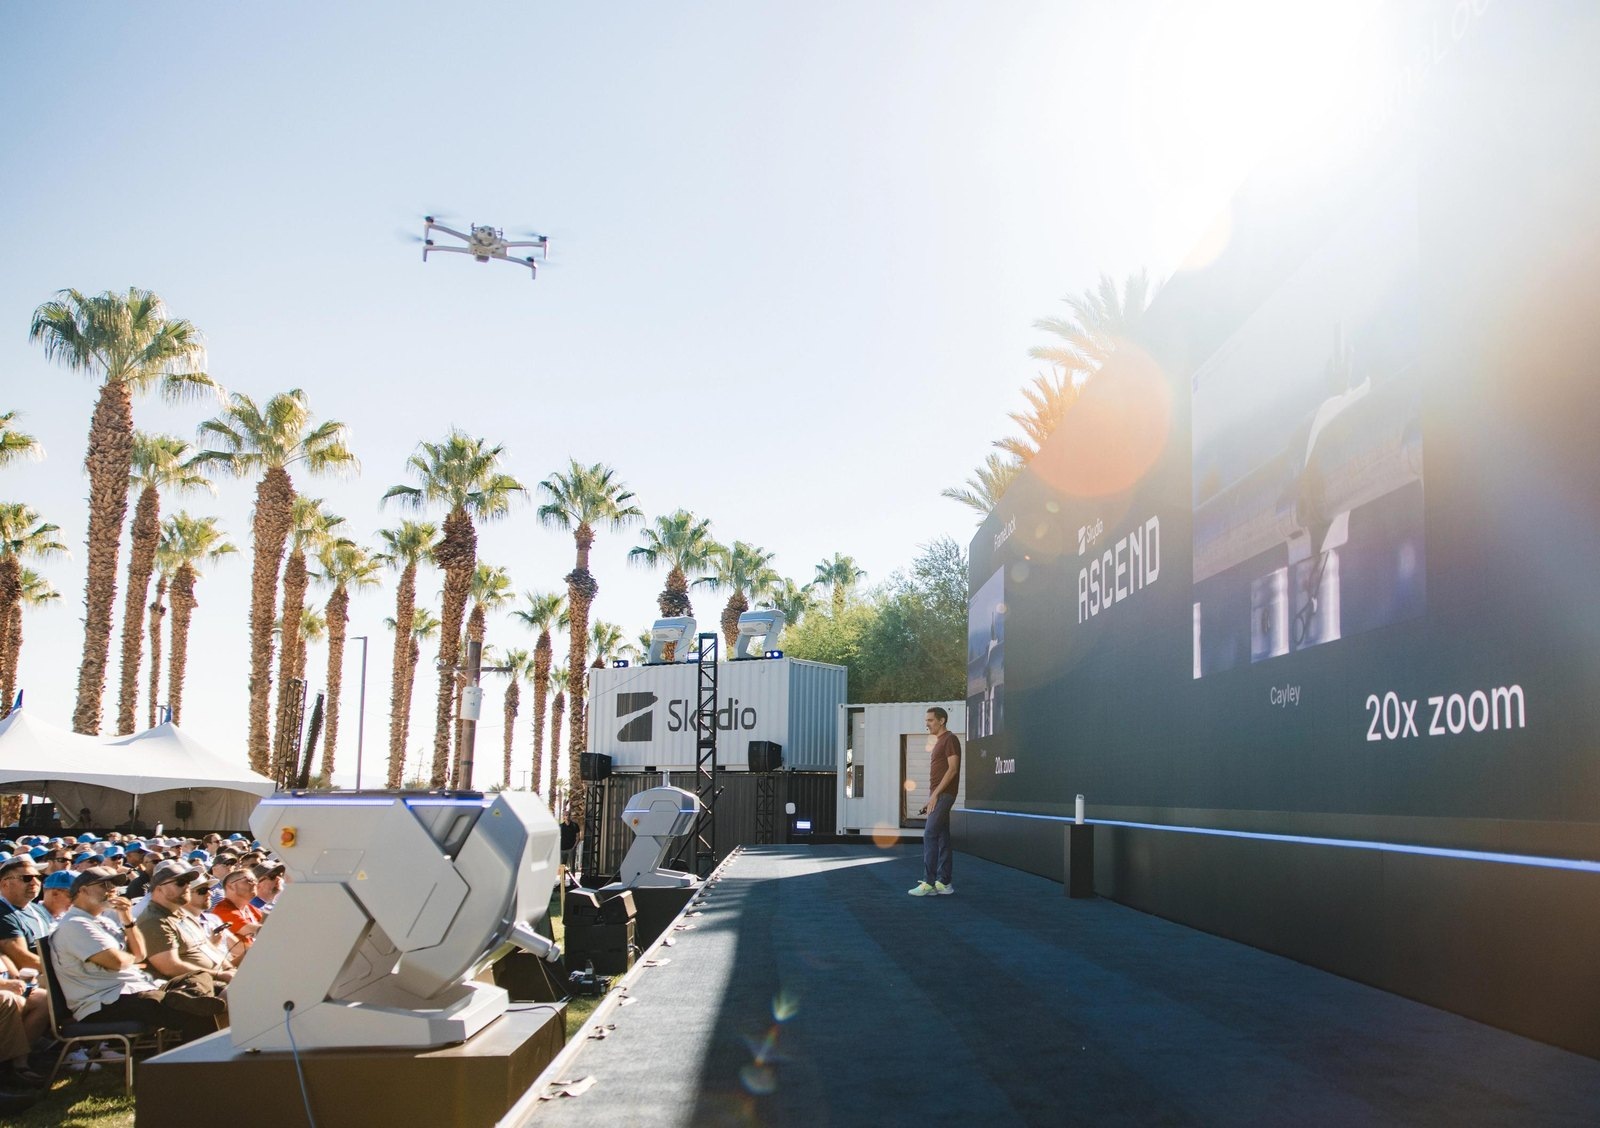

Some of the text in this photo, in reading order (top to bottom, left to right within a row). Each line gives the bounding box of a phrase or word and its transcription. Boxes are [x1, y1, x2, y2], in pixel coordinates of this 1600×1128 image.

[1078, 514, 1161, 625] ASCEND
[1270, 683, 1301, 708] Cayley
[1365, 683, 1527, 742] 20x zoom
